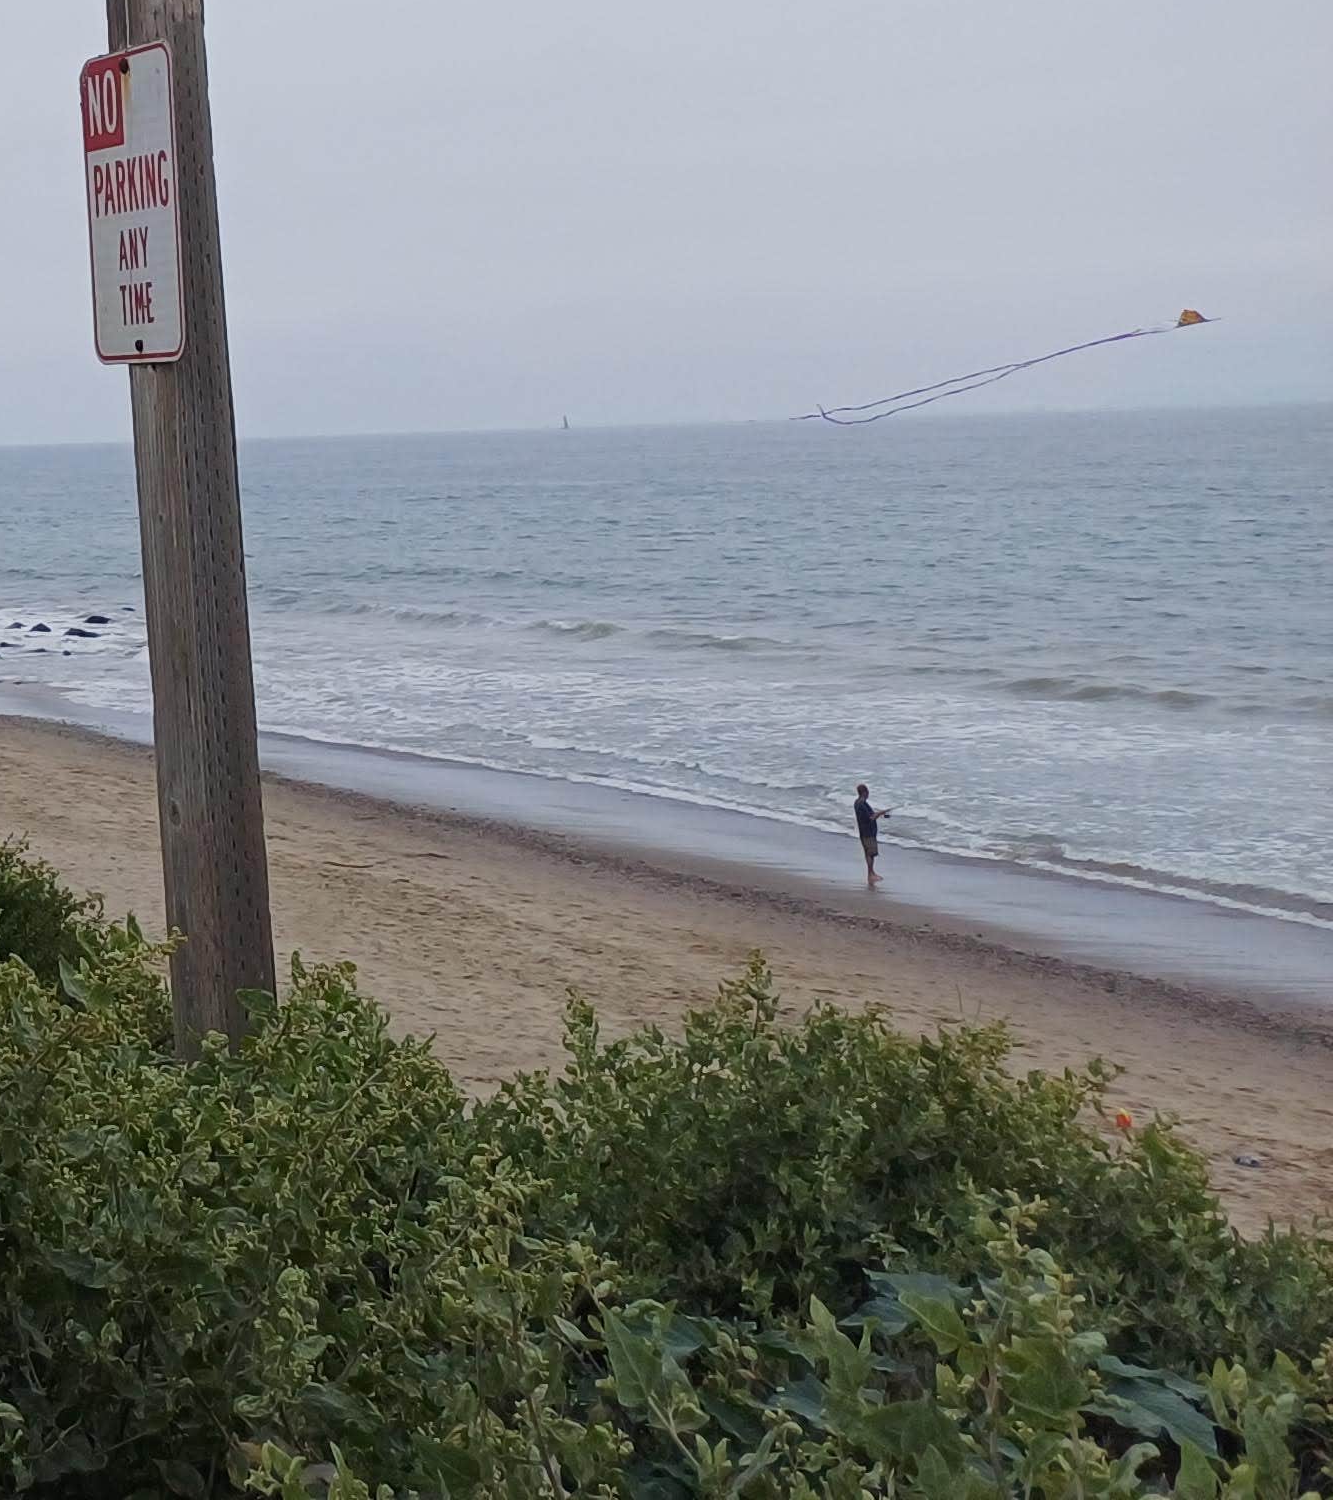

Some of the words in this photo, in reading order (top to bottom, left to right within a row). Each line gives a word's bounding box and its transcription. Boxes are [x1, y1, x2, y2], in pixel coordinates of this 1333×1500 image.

[87, 69, 117, 138] NO
[93, 150, 169, 218] PARKING
[119, 226, 149, 271] ANY
[120, 282, 155, 326] TIME
